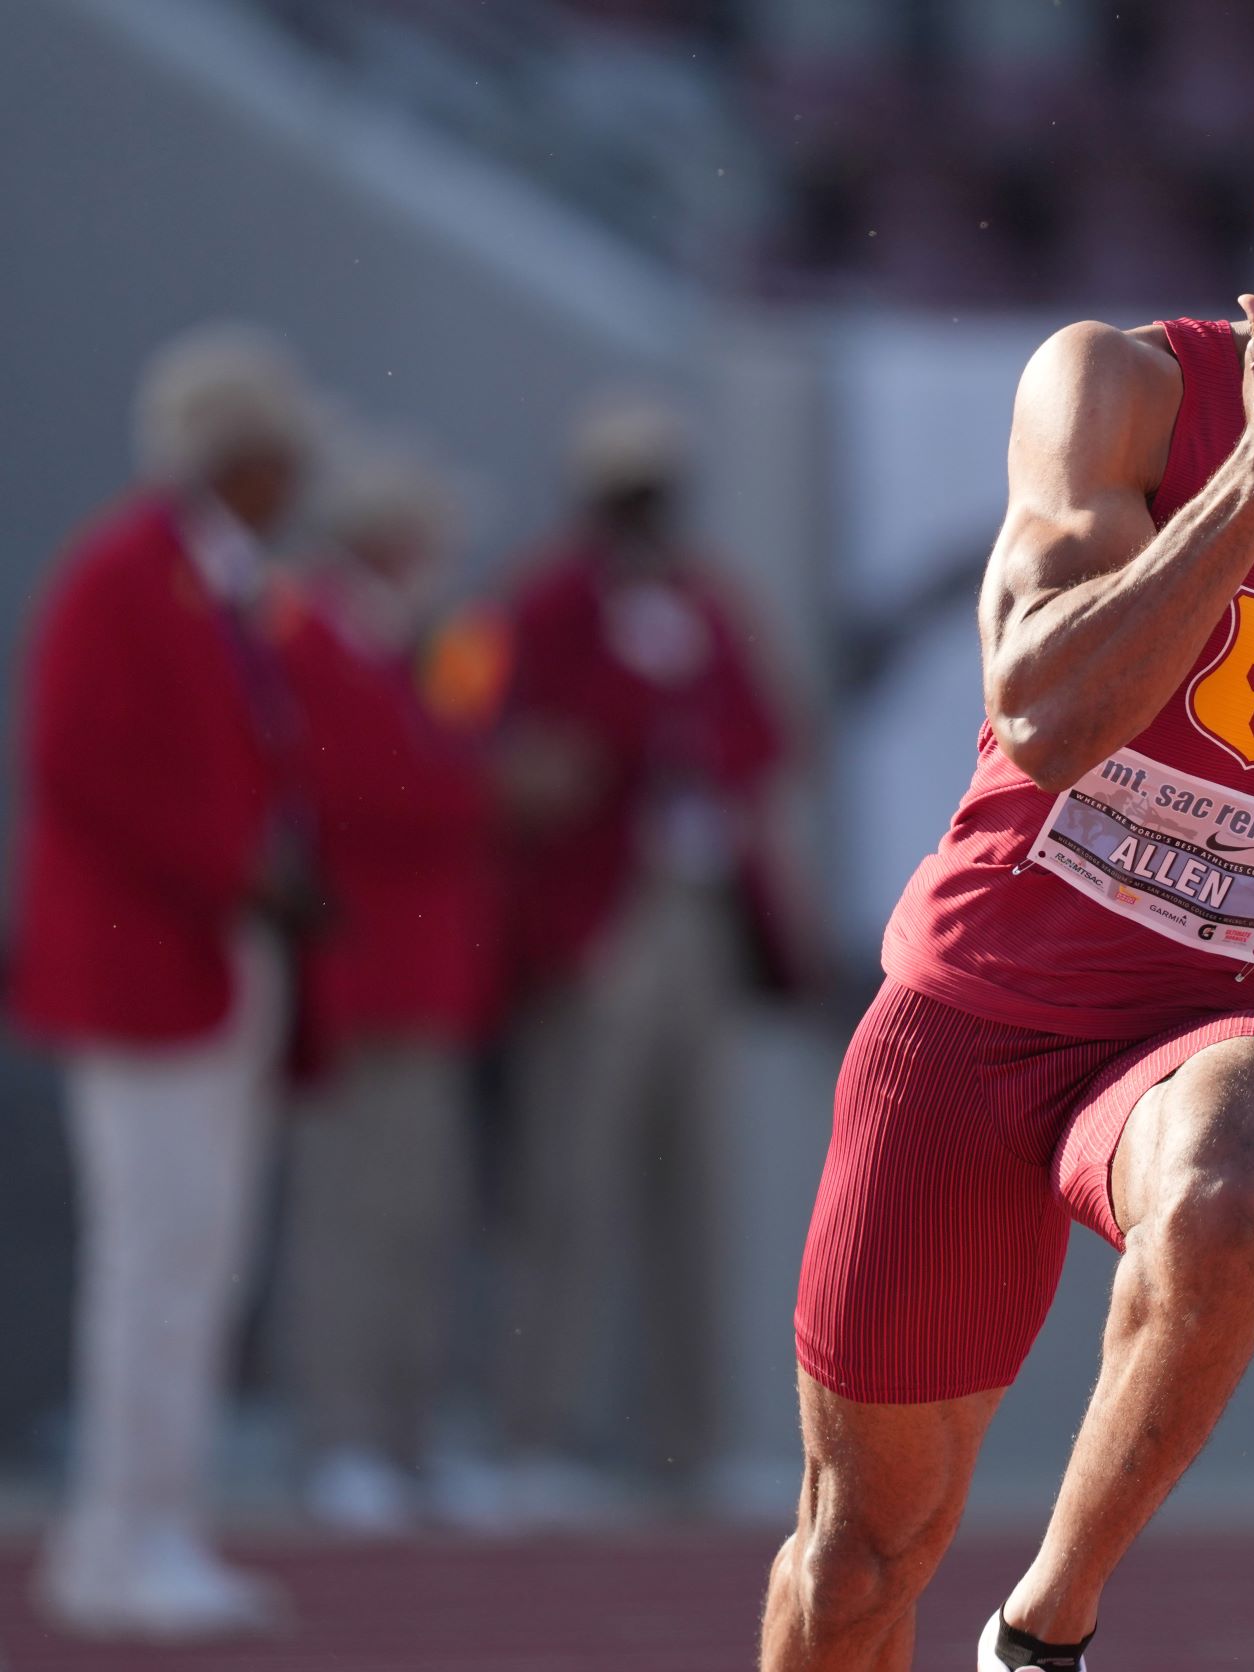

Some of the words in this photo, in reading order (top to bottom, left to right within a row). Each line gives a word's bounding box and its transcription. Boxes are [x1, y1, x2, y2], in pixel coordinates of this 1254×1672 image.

[1101, 759, 1148, 797] mt.
[1155, 784, 1213, 818] sac
[1076, 793, 1107, 812] WHERE
[1111, 811, 1127, 825] THE
[1130, 825, 1171, 844] WORLD'S
[1175, 841, 1198, 853] BEST
[1200, 851, 1244, 874] ATHLETES
[1108, 834, 1233, 910] ALLEN
[1149, 904, 1187, 928] GARMIN
